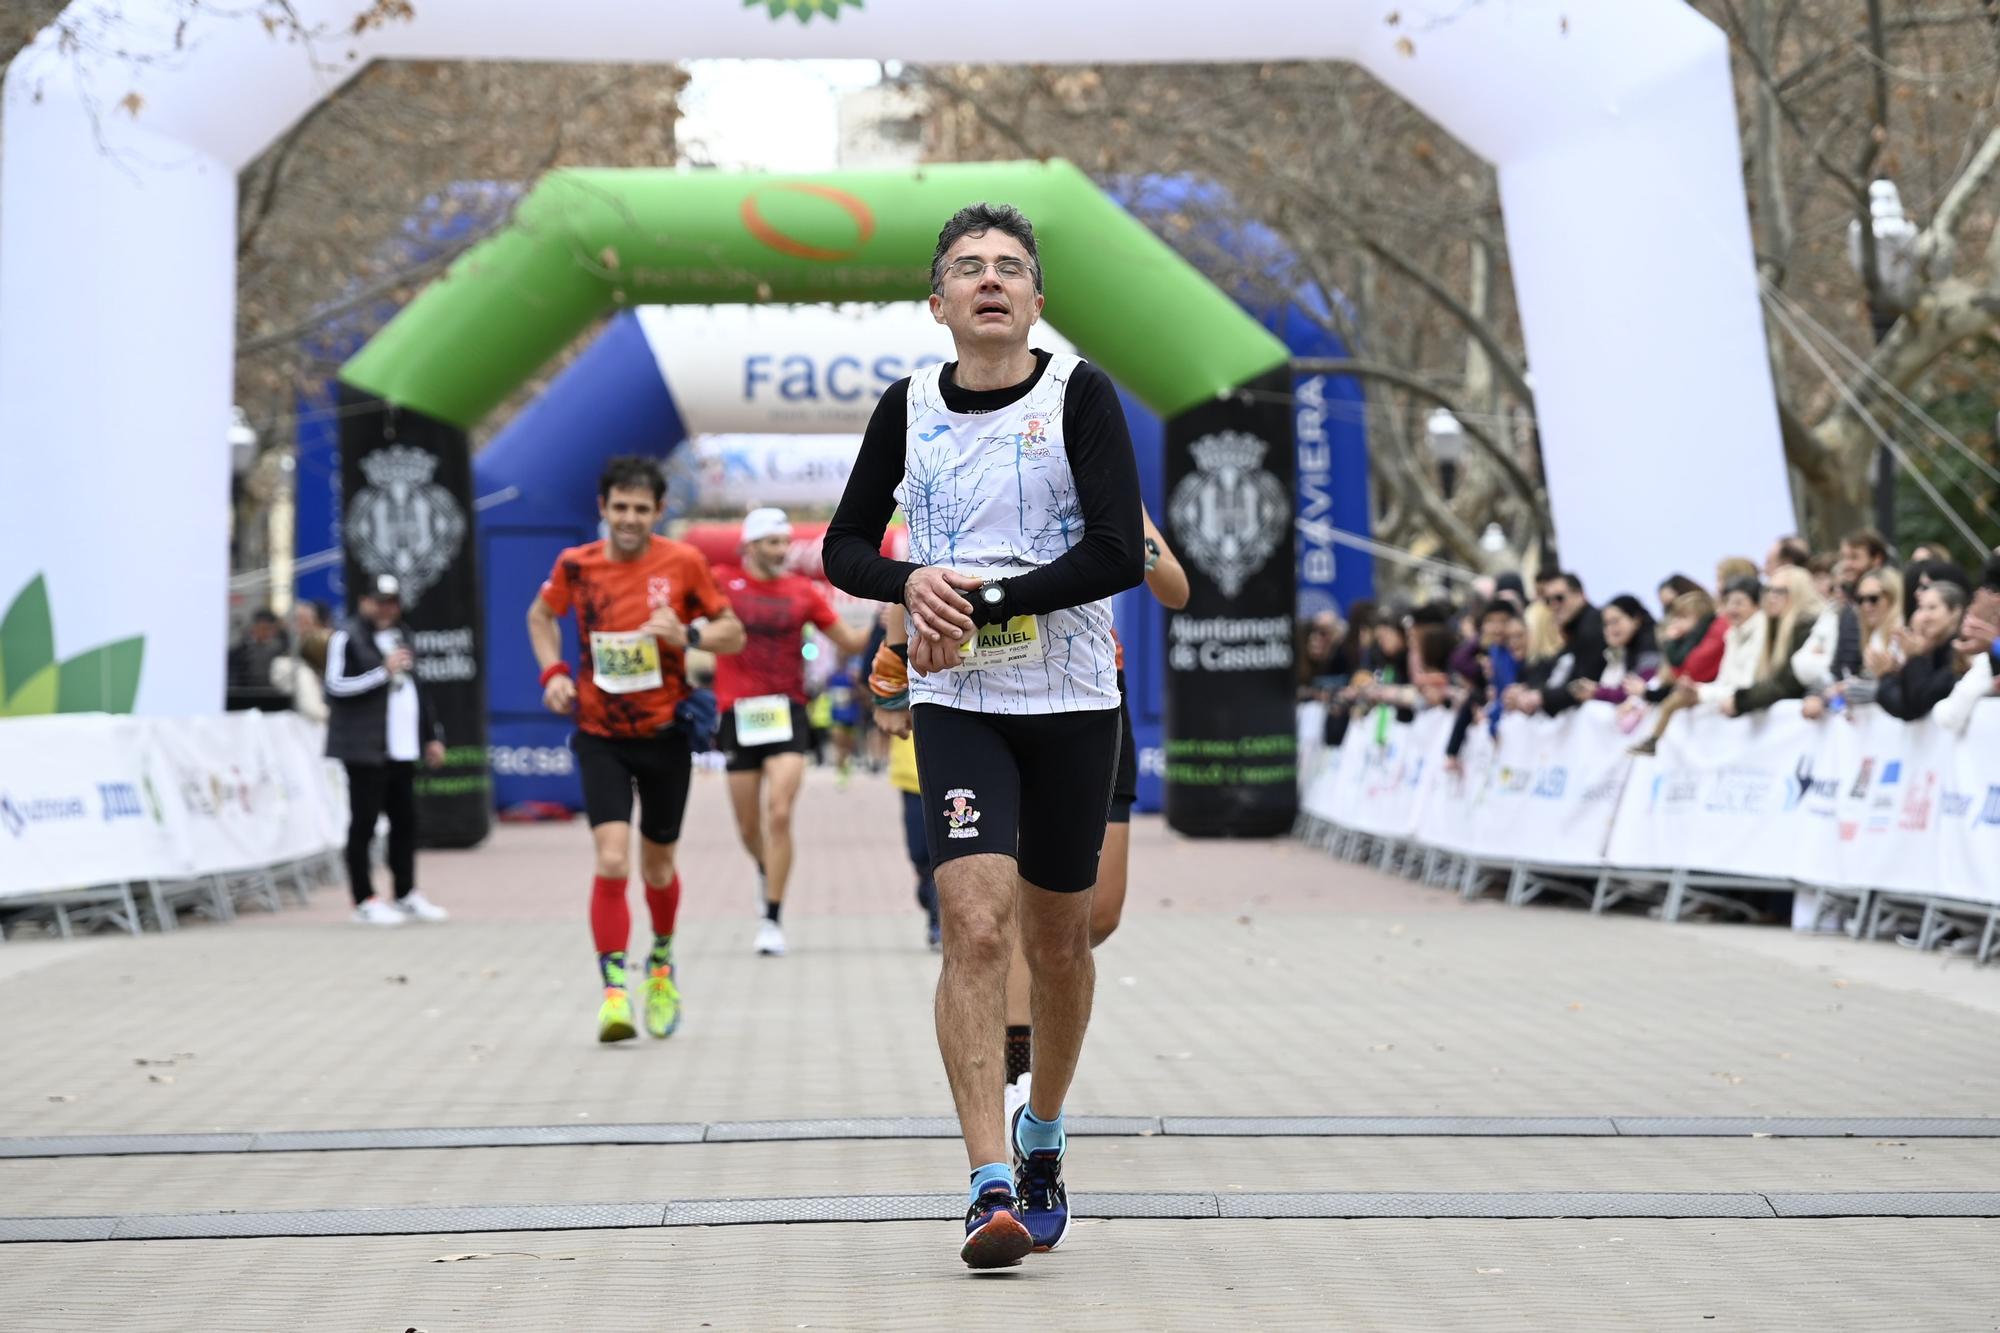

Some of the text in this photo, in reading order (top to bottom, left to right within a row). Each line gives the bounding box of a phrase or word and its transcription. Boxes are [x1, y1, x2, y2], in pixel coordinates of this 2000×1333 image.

[744, 354, 949, 400] Facs
[1296, 374, 1336, 584] BAVIERA
[1169, 615, 1292, 641] Ajuntament
[605, 648, 644, 667] 234
[1169, 643, 1197, 671] de
